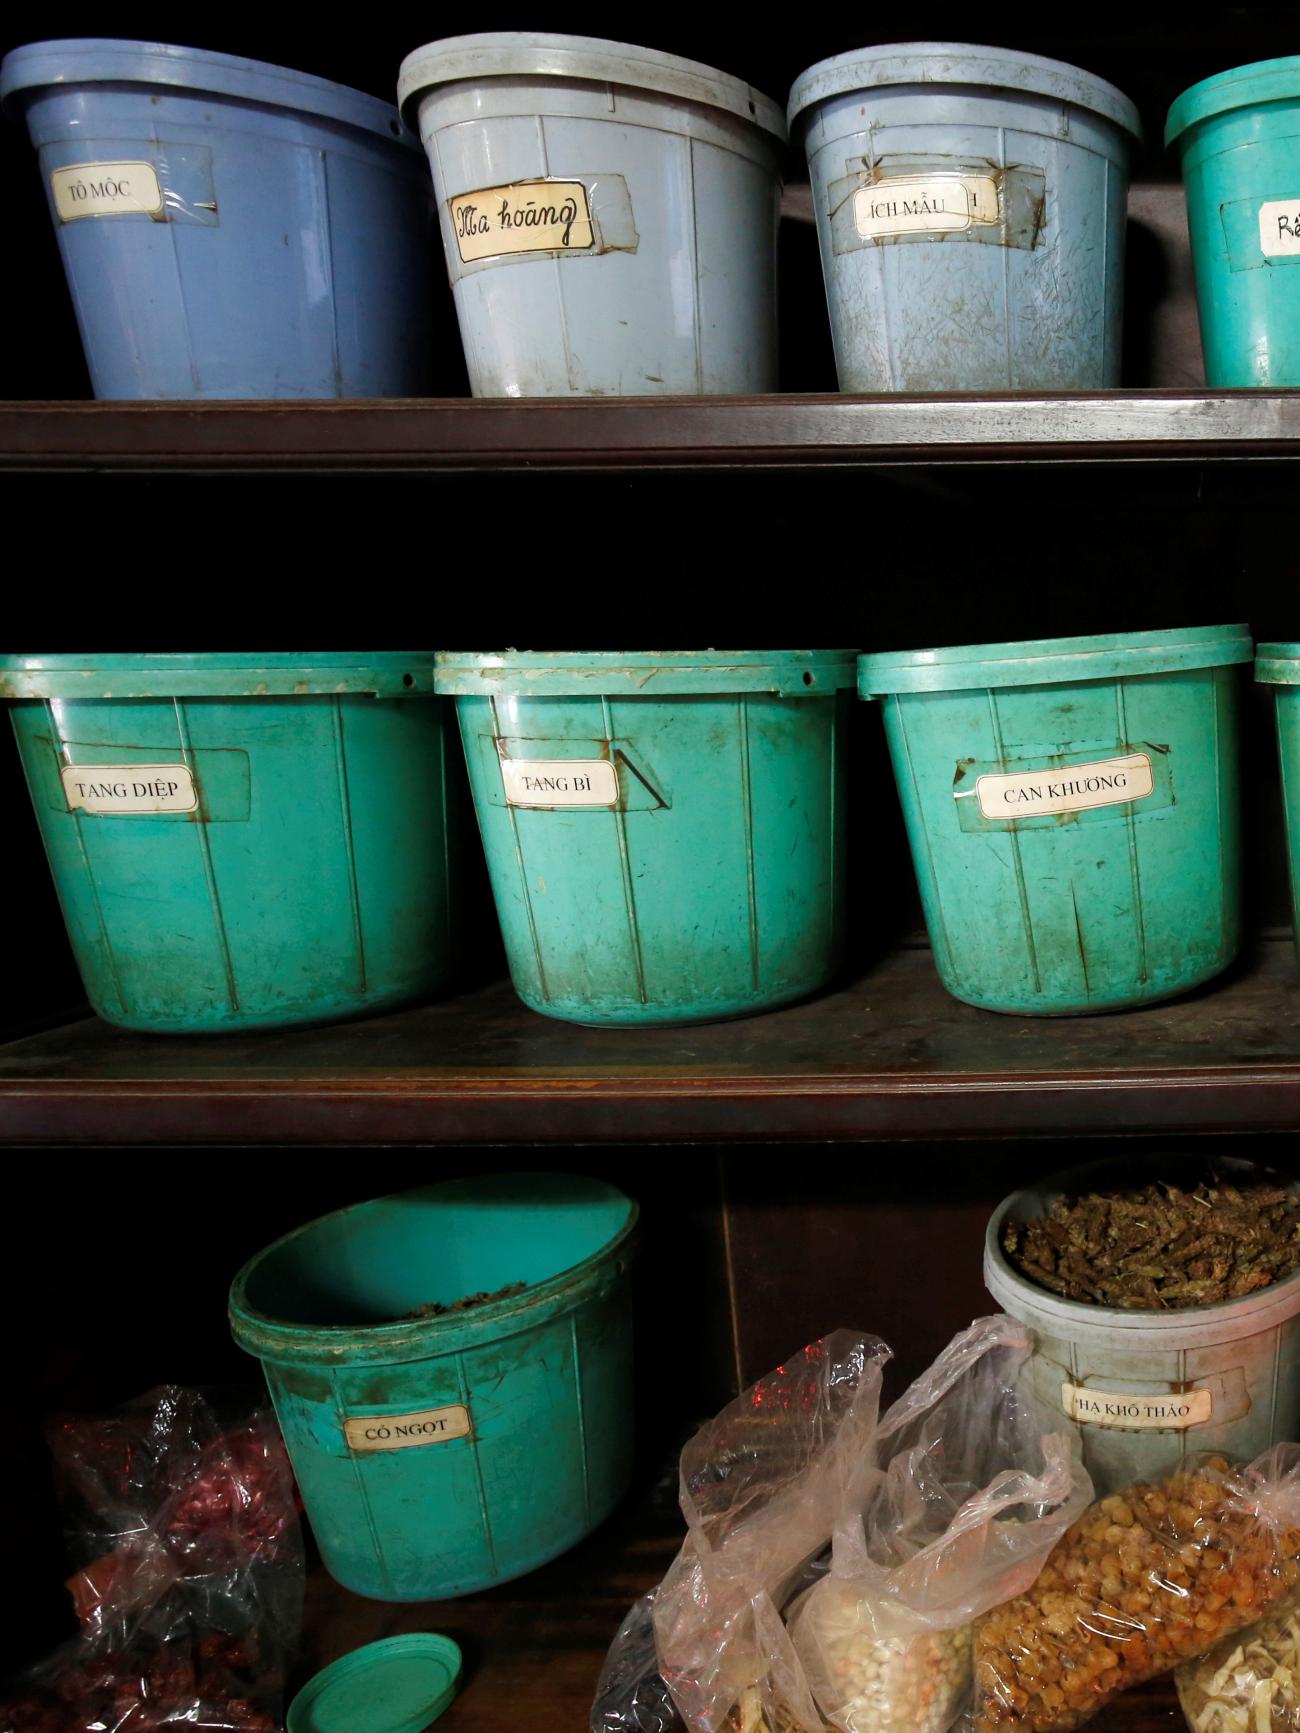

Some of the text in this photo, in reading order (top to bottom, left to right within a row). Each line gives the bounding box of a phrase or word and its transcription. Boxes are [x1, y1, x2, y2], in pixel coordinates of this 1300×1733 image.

[91, 177, 130, 201] MỘC
[869, 200, 897, 219] ÍCH
[902, 192, 945, 215] MẪU
[75, 778, 179, 800] TANG DIỆP
[521, 773, 592, 792] TANG BÌ
[1003, 773, 1127, 804] CAN KHƯƠNG
[1079, 1399, 1101, 1417] HẠ
[1143, 1402, 1190, 1418] THẢO
[395, 1418, 448, 1438] NGỌT
